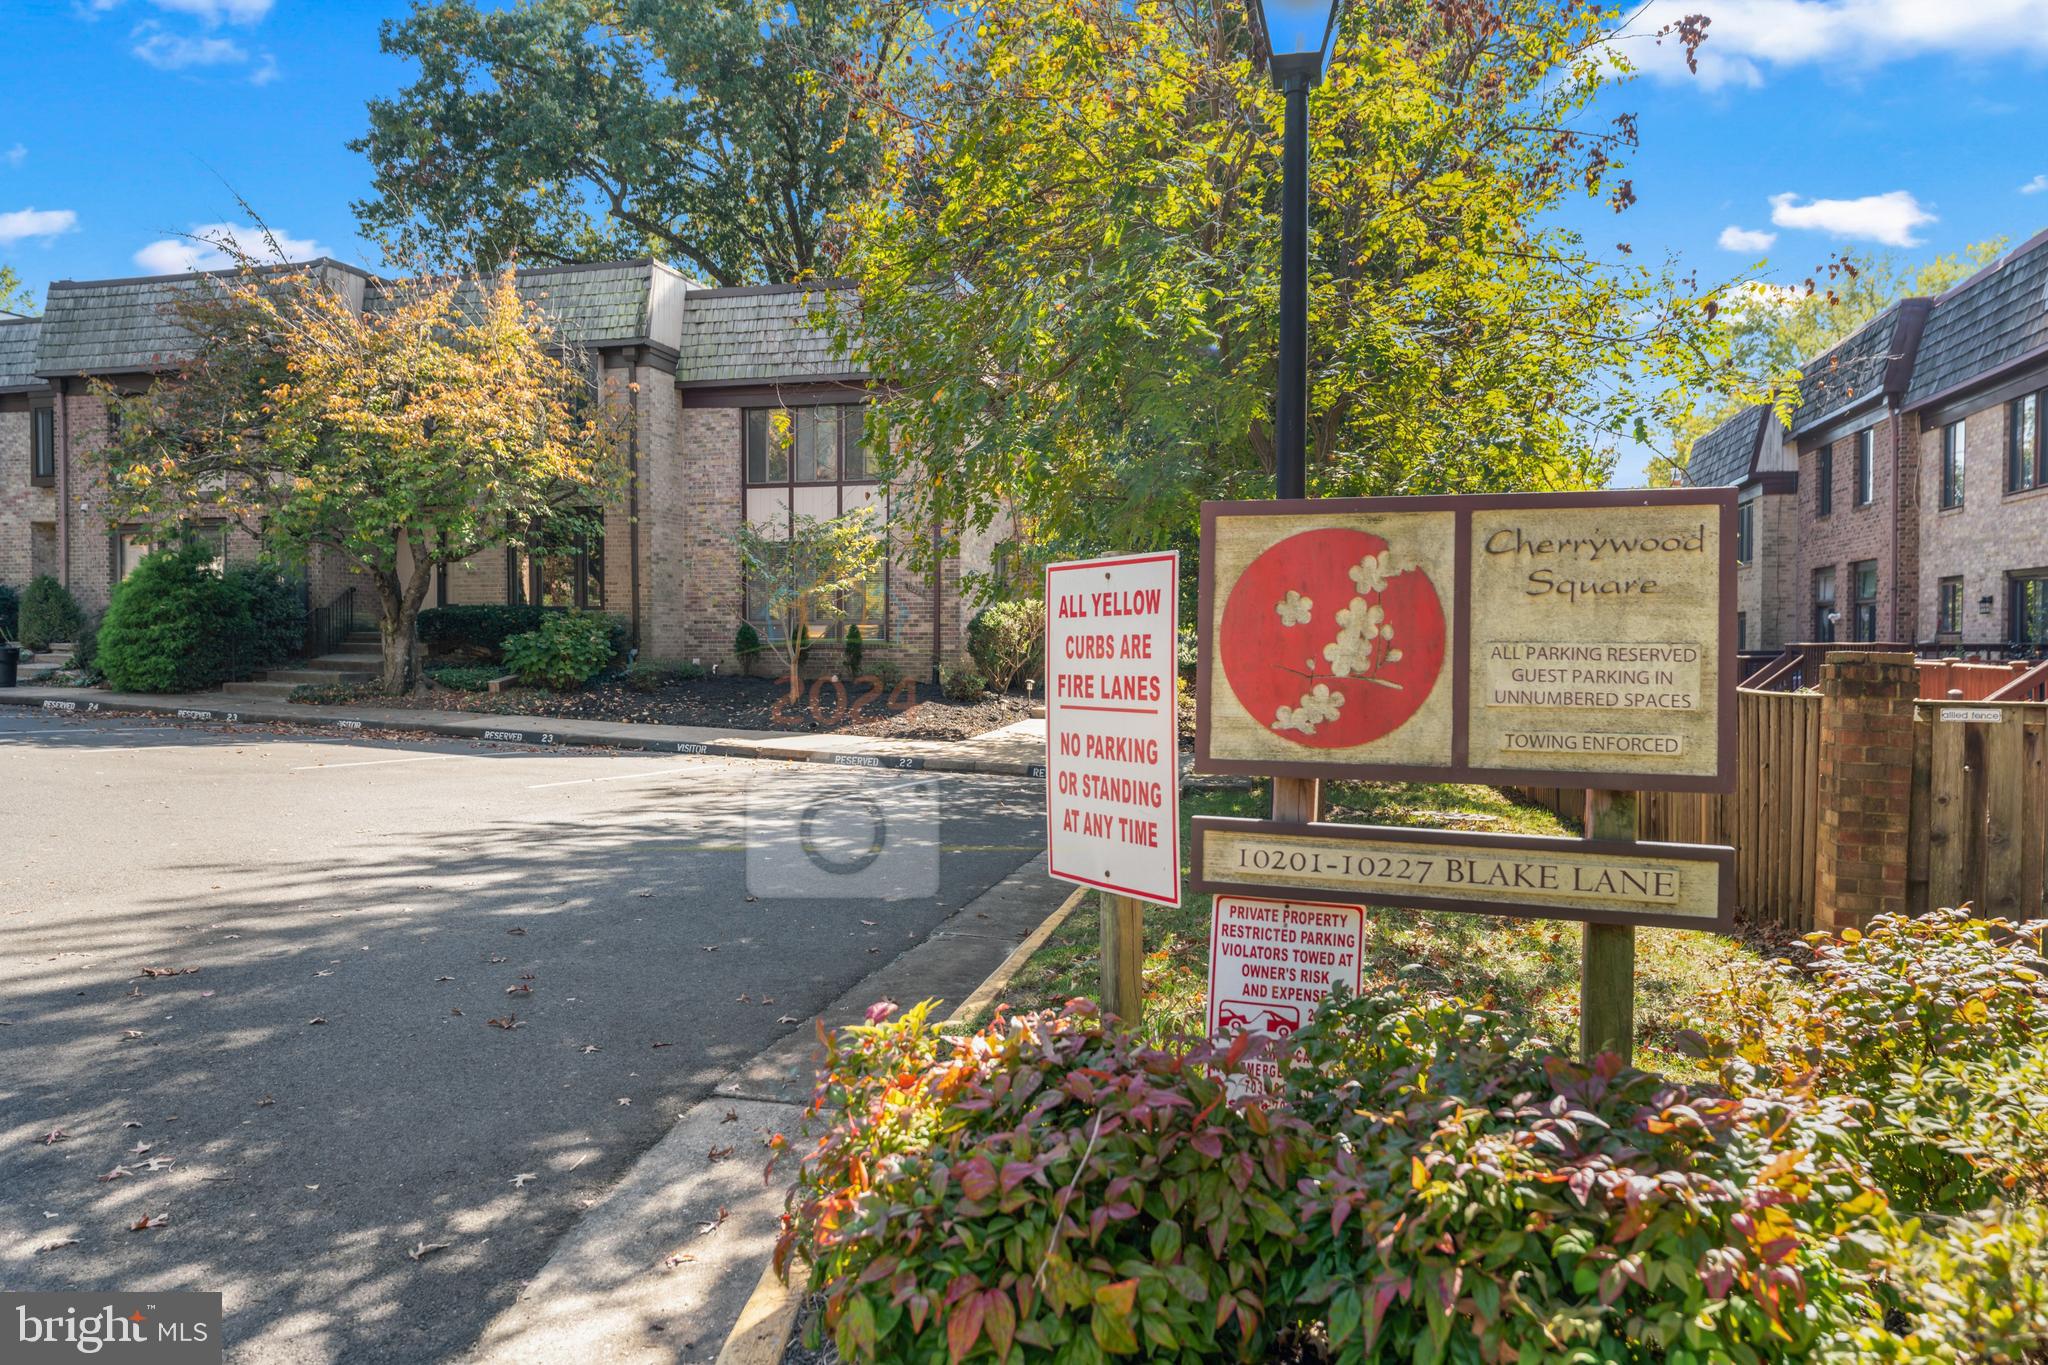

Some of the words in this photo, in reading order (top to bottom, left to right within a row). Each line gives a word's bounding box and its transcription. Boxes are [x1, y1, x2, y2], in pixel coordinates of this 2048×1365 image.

[1485, 524, 1705, 561] Cherrywood
[1526, 569, 1660, 603] Square
[1058, 594, 1087, 619] ALL
[1091, 588, 1162, 617] YELLOW
[1065, 635, 1115, 660] CURBS
[1120, 633, 1153, 660] ARE
[1491, 646, 1521, 661] ALL
[1526, 646, 1602, 662] PARKING
[1607, 647, 1698, 663] RESERVED
[1057, 674, 1095, 699] FIRE
[1100, 675, 1161, 702] LANES
[1511, 668, 1568, 683] GUEST
[1572, 669, 1649, 685] PARKING
[1655, 671, 1673, 685] IN
[1495, 690, 1619, 707] UNNUMBERED
[1624, 693, 1692, 709] SPACES
[1943, 711, 1969, 719] allied
[1971, 711, 1999, 720] fence
[484, 730, 523, 741] RESERVED
[541, 733, 554, 743] 23
[1505, 733, 1577, 751] TOWING
[1583, 735, 1679, 753] ENFORCED
[677, 743, 708, 754] VISITOR
[1060, 732, 1081, 757] NO
[1086, 734, 1159, 765] PARKING
[834, 755, 880, 767] RESERVED
[899, 758, 913, 768] 22
[1058, 770, 1078, 797] OR
[1082, 774, 1162, 809] STANDING
[1063, 808, 1080, 833] AT
[1083, 810, 1113, 840] ANY
[1119, 817, 1158, 848] TIME
[1239, 847, 1434, 885] 10201-10227
[1445, 858, 1560, 892] BLAKE
[1572, 866, 1676, 898] LANE
[1229, 905, 1279, 923] PRIVATE
[1283, 910, 1348, 928] PROPERTY
[1221, 923, 1297, 943] RESTRICTED
[1300, 931, 1356, 948] PARKING
[1221, 943, 1289, 962] VIOLATORS
[1293, 950, 1335, 966] TOWED
[1338, 953, 1354, 967] AT
[1241, 964, 1297, 982] OWNER'S
[1300, 970, 1330, 985] RISK
[1242, 984, 1268, 998] AND
